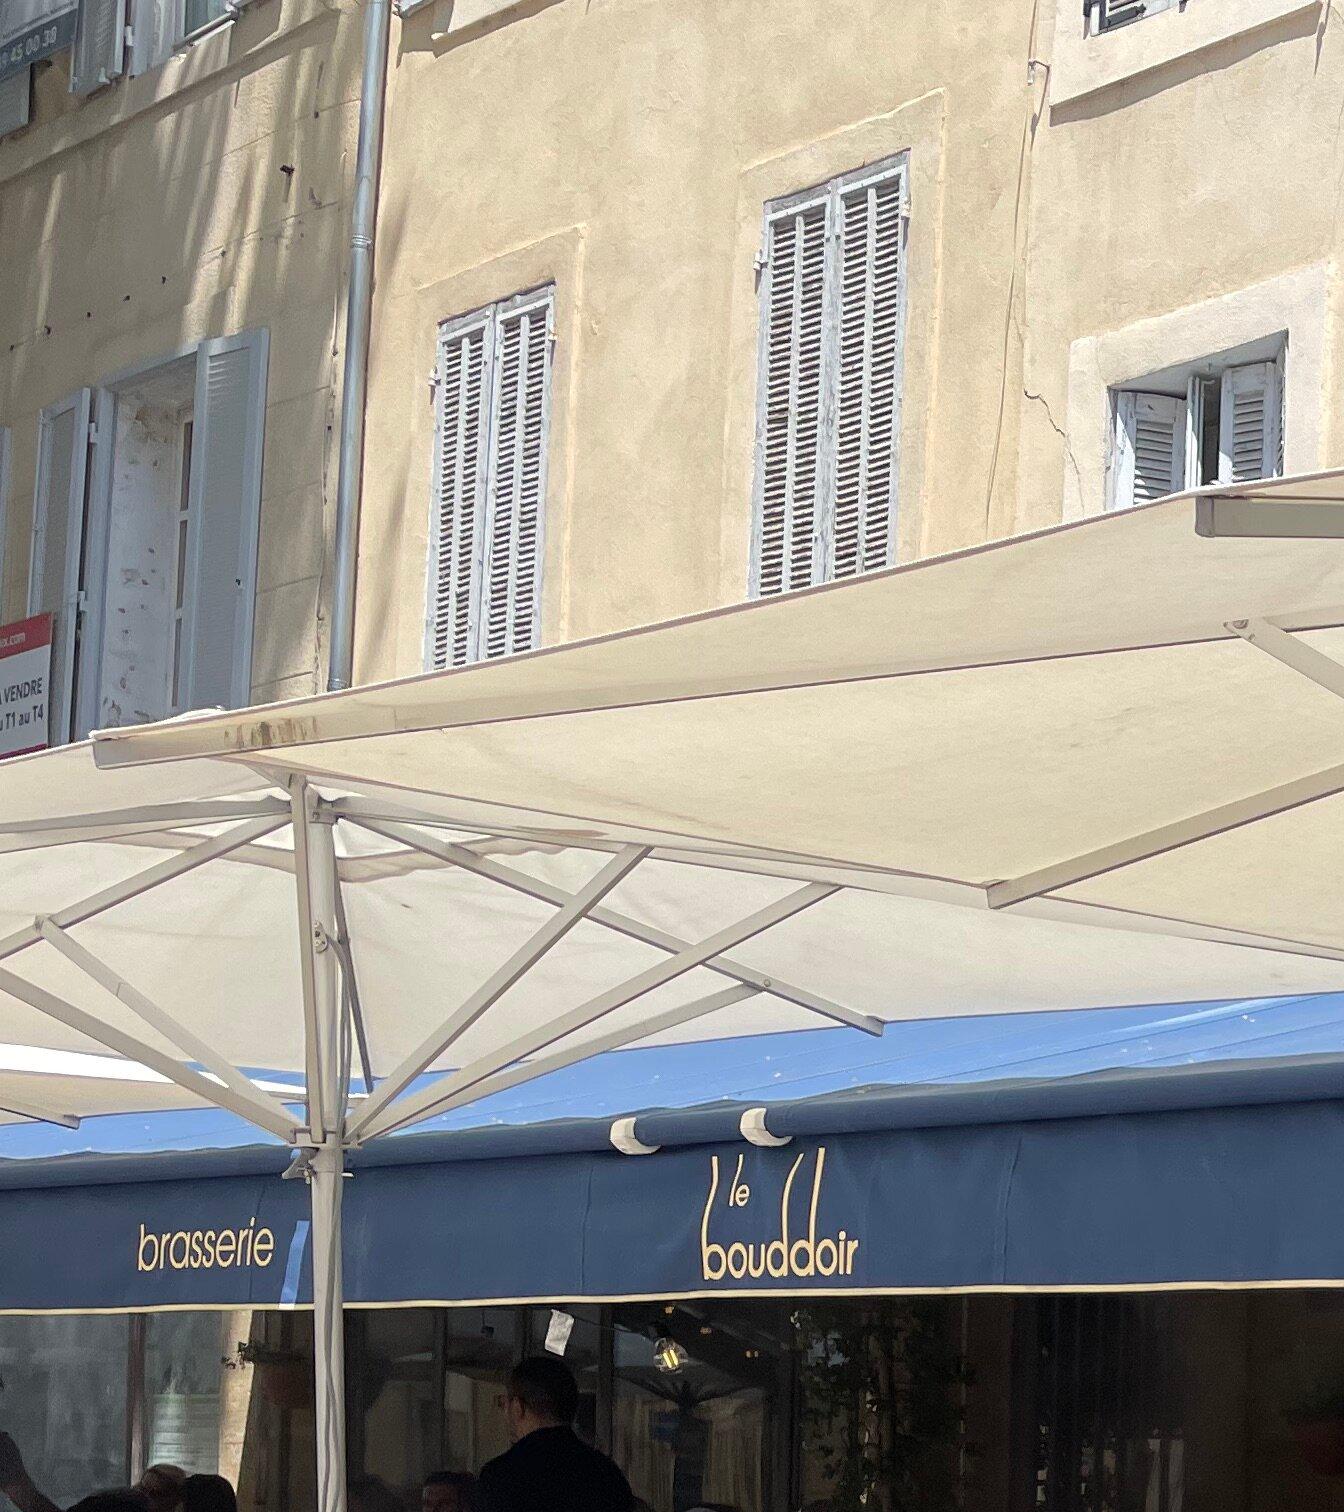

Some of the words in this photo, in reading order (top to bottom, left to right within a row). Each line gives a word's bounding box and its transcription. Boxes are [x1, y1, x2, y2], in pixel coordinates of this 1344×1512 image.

[4, 677, 43, 703] VENDRE
[6, 712, 16, 729] T1
[19, 713, 31, 725] au
[32, 704, 44, 721] T4
[728, 1154, 750, 1208] le
[701, 1147, 860, 1282] bouddoir
[137, 1217, 274, 1271] brasserie
